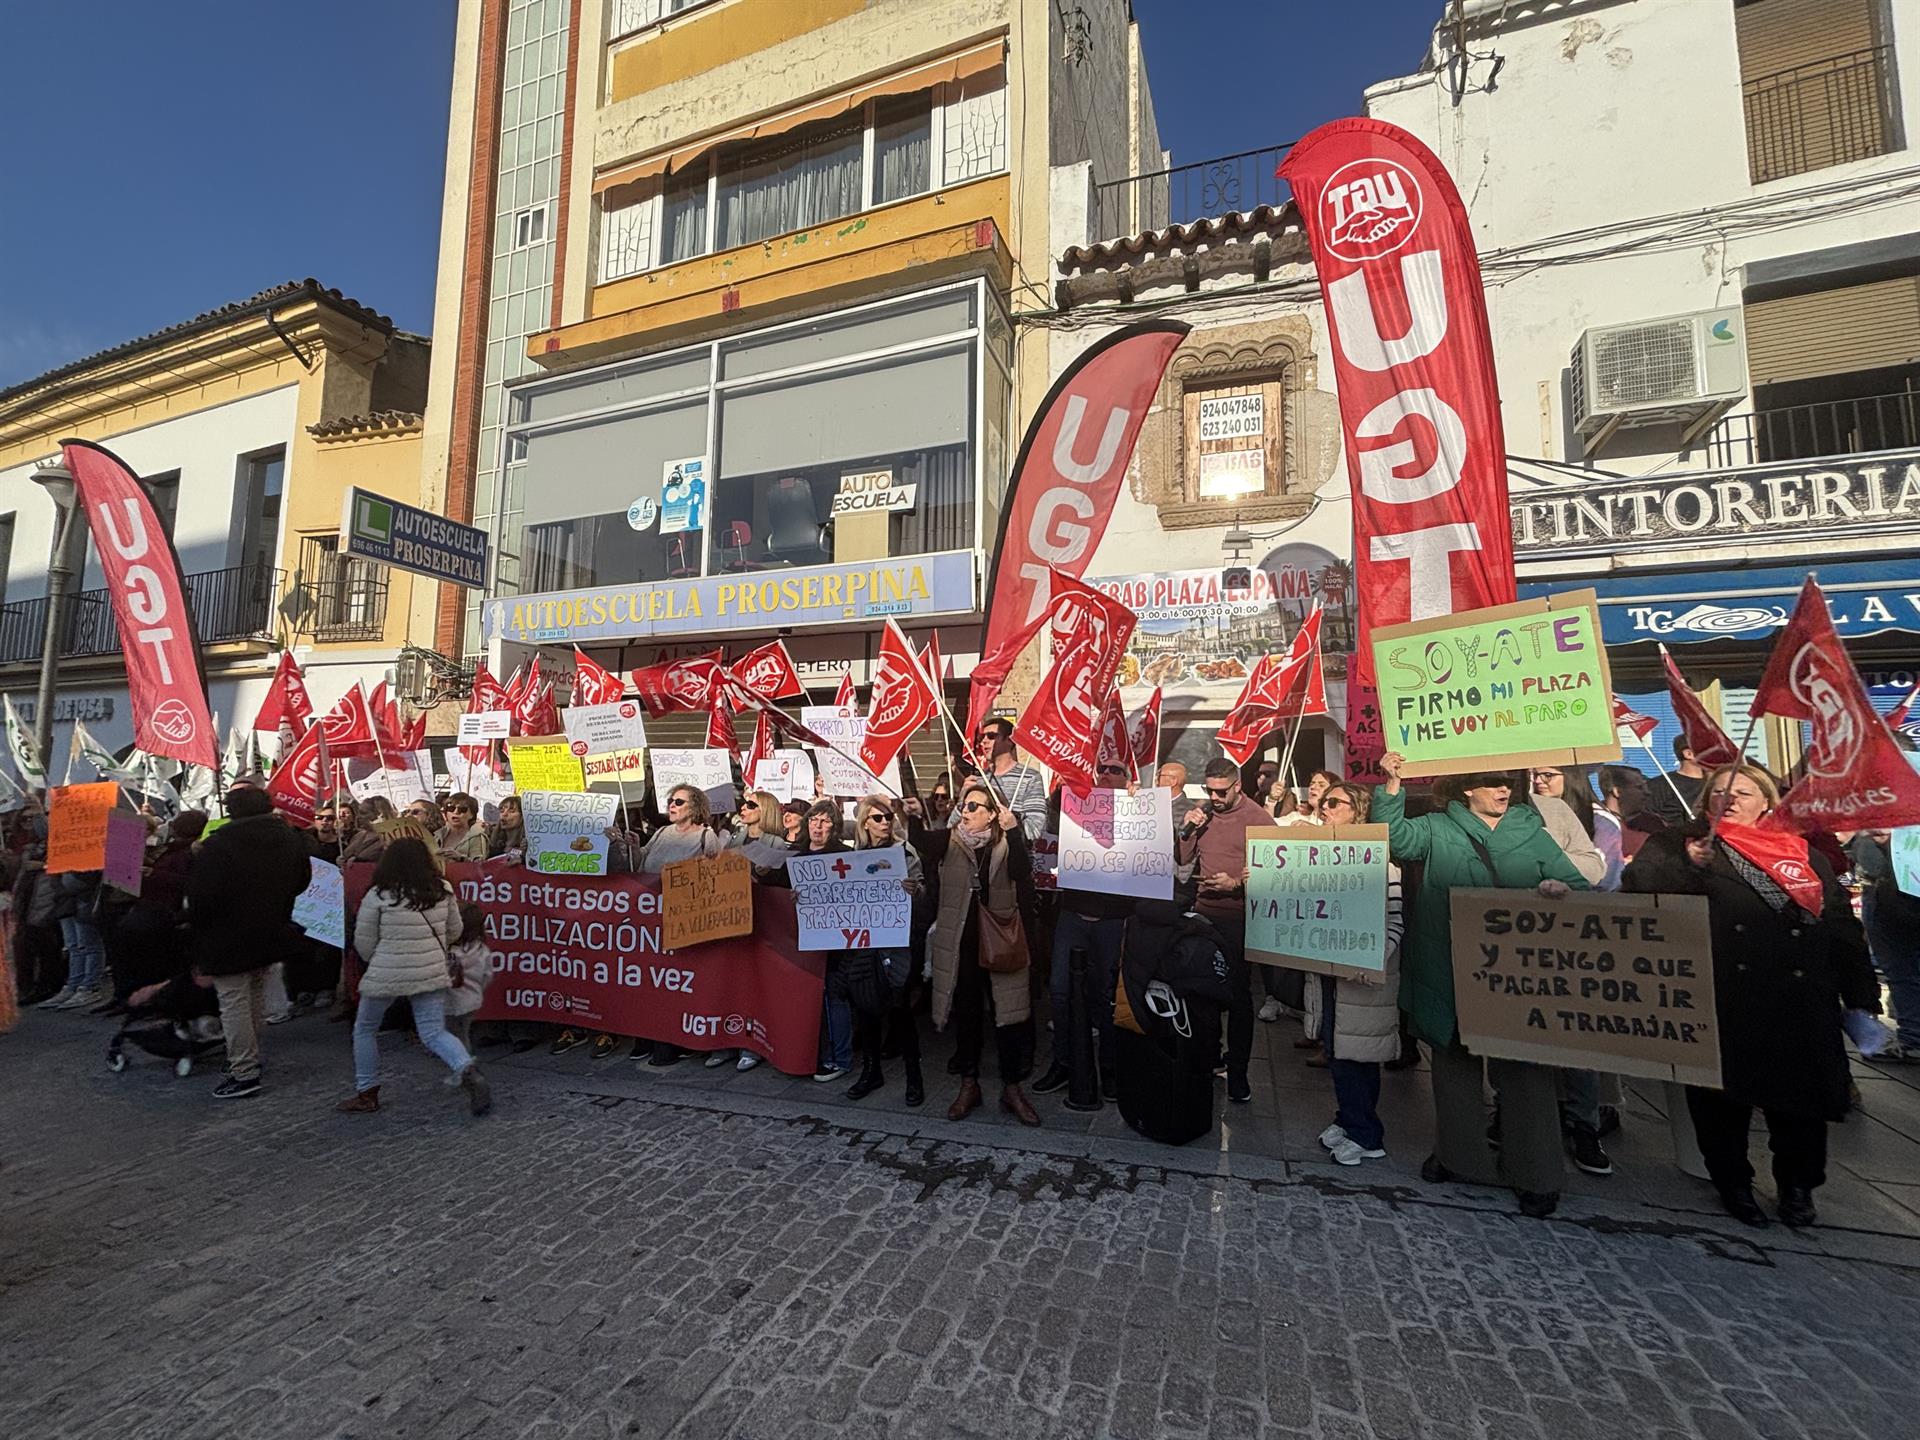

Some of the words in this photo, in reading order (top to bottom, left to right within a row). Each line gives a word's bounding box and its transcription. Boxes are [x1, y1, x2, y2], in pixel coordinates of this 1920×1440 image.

[1202, 421, 1220, 437] 623
[1222, 418, 1241, 434] 240
[841, 473, 891, 494] AUTO
[833, 491, 908, 512] ESCUELA
[394, 508, 484, 557] AUTOESCUELA
[393, 536, 482, 582] PROSERPINA
[1154, 574, 1221, 607] PLAZA
[1225, 562, 1312, 601] ESPAÑA
[510, 586, 703, 632] AUTOESCUELA
[716, 564, 930, 617] PROSERPINA
[1389, 615, 1584, 692] SOY-ATE
[746, 655, 784, 683] UGT
[796, 660, 852, 674] ETERO
[1397, 686, 1482, 720] FIRMO
[1491, 681, 1513, 700] MI
[1522, 671, 1591, 696] PLAZA
[1417, 720, 1447, 742] ME
[1451, 714, 1488, 736] VOY
[1495, 711, 1520, 729] AL
[1524, 698, 1588, 724] PARO
[1063, 792, 1156, 816] NUESTROS
[1081, 819, 1157, 841] DERECHOS
[539, 850, 602, 873] PERRAS
[1063, 850, 1097, 872] NO
[1102, 851, 1127, 873] SE
[1251, 844, 1288, 869] LOS
[1294, 844, 1383, 868] TRASLADOS
[793, 859, 828, 882] NO
[459, 876, 512, 904] más
[520, 883, 630, 915] retrasos
[794, 879, 907, 905] CARRETERA
[799, 904, 909, 929] TRASLADOS
[1285, 898, 1344, 921] PLAZA
[1483, 908, 1665, 942] SOY-ATE
[841, 928, 871, 949] YA
[490, 951, 587, 980] oración
[594, 964, 609, 984] a
[617, 956, 641, 987] la
[650, 965, 695, 994] vez
[1479, 943, 1499, 968] Y
[1516, 947, 1615, 973] TENGO
[1632, 957, 1697, 979] QUE
[506, 989, 547, 1009] UGT
[1580, 976, 1642, 1003] POR
[682, 1012, 721, 1036] UGT
[1527, 1007, 1547, 1030] A
